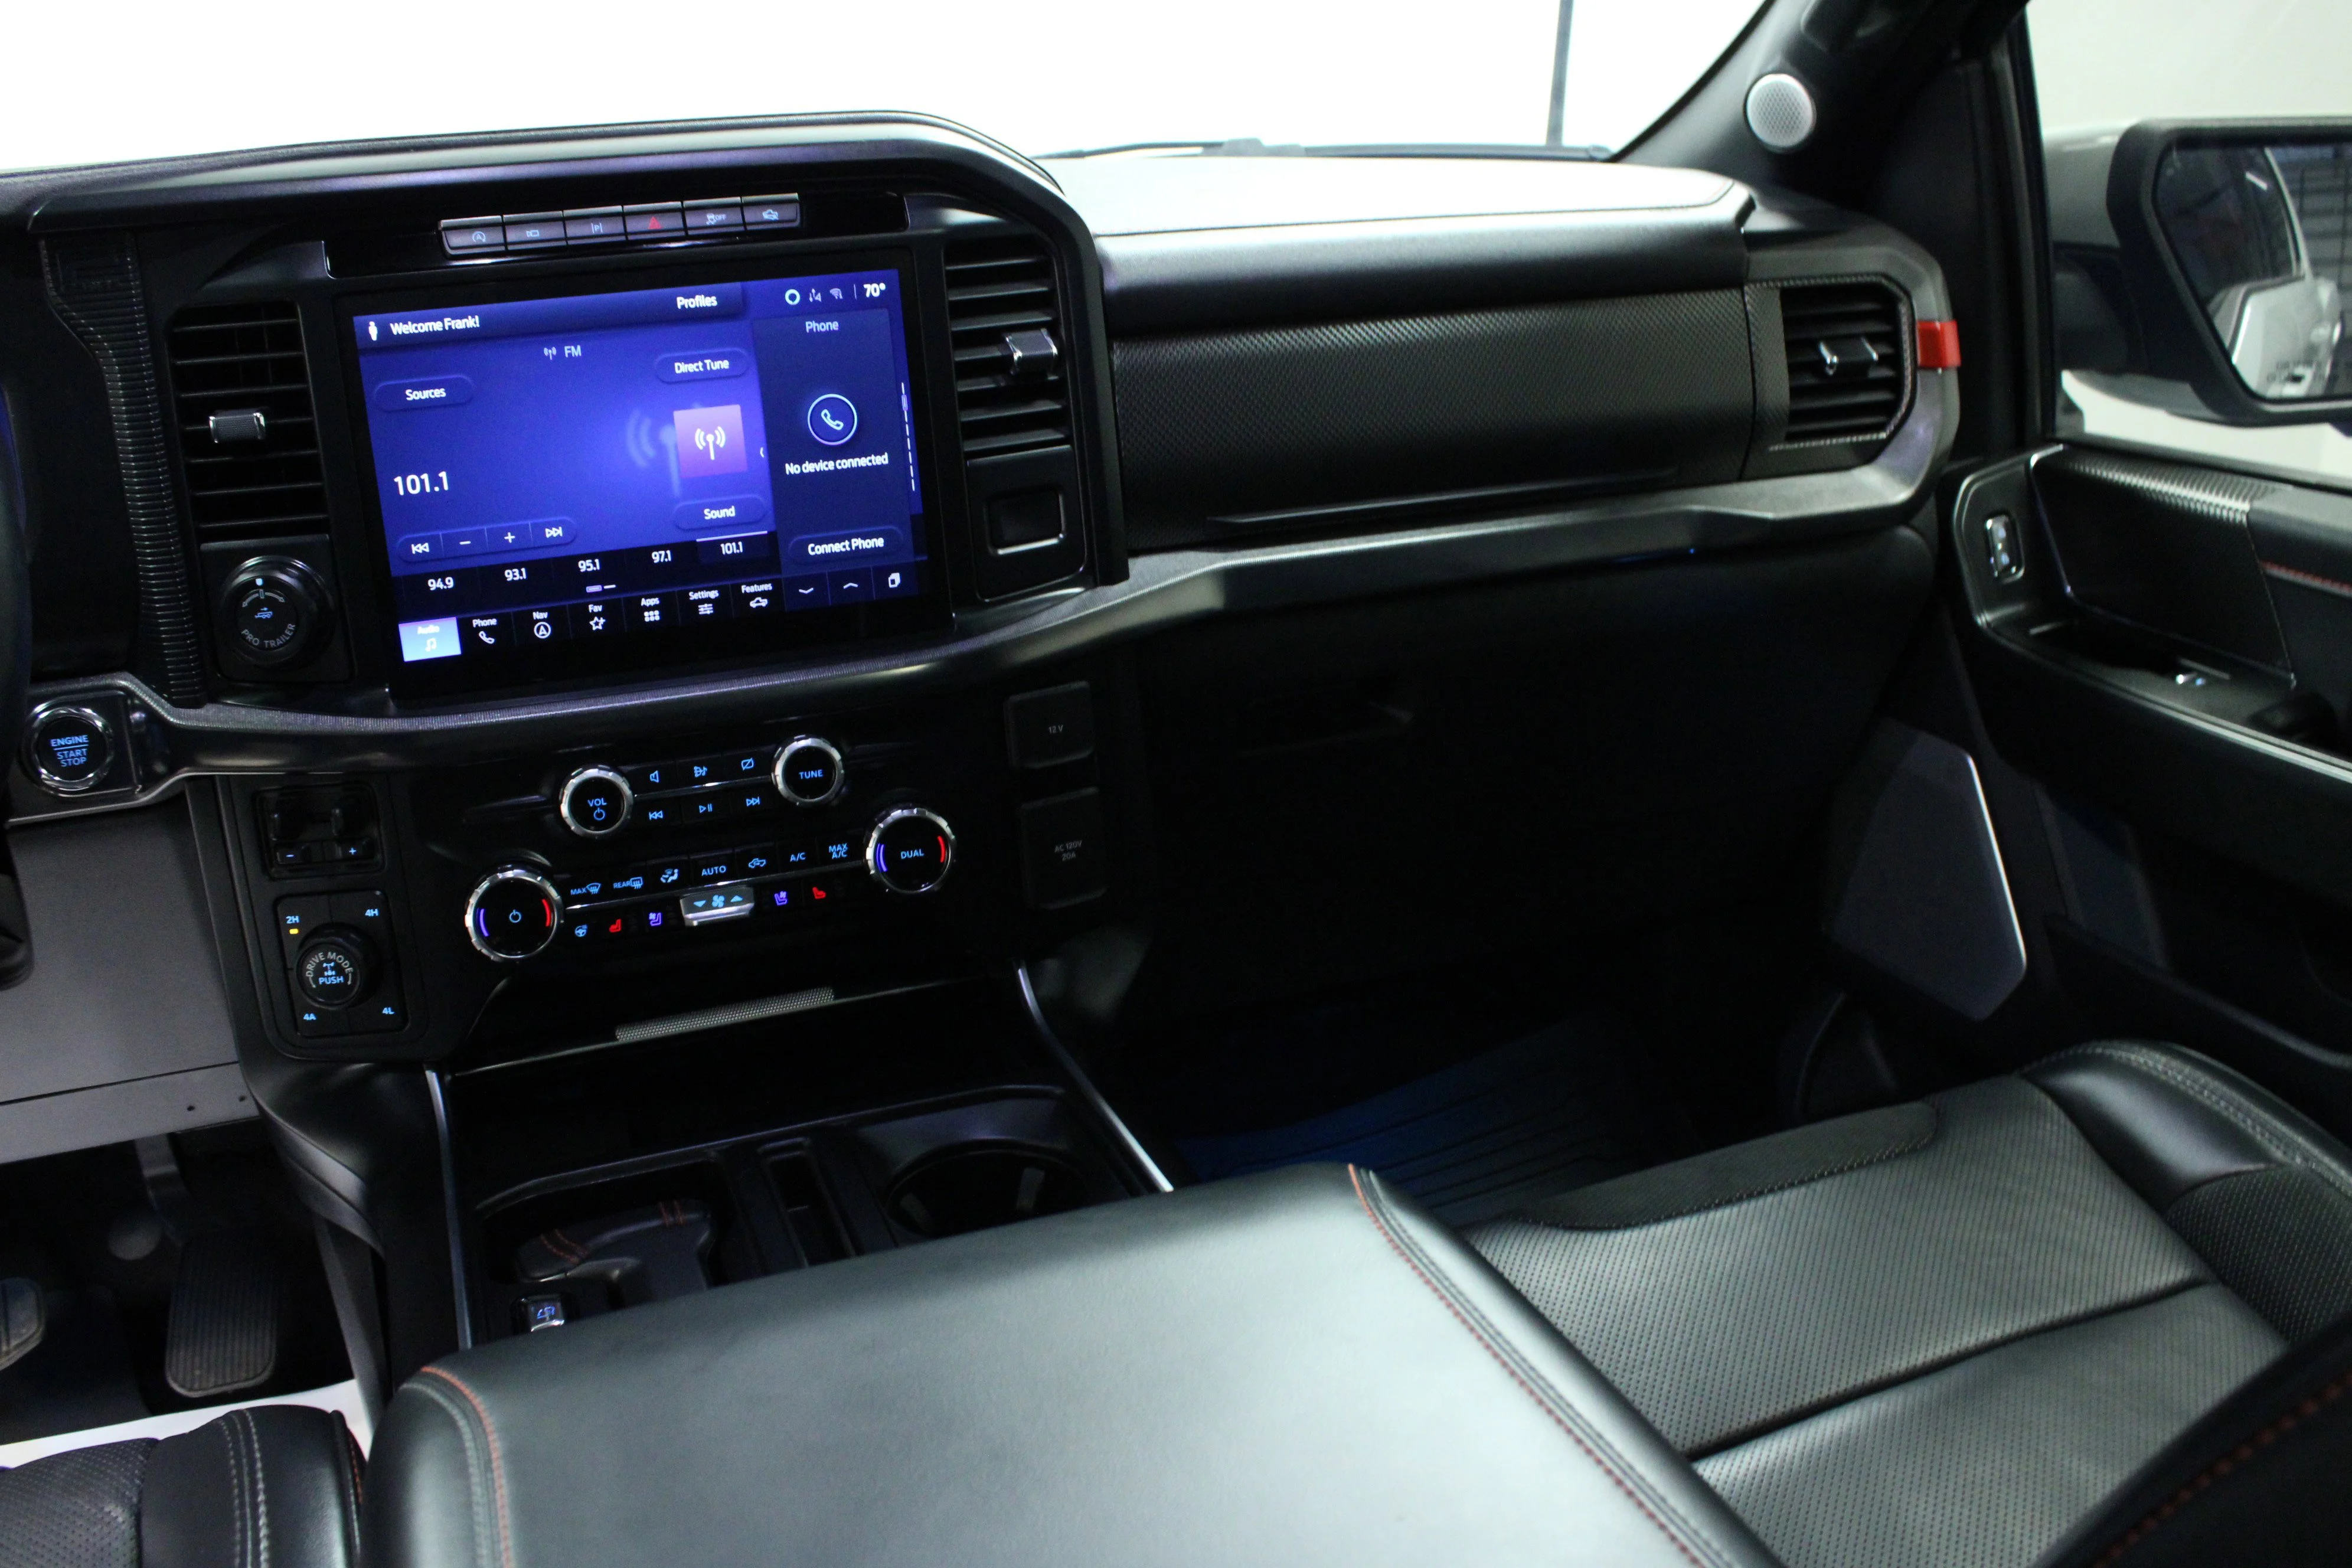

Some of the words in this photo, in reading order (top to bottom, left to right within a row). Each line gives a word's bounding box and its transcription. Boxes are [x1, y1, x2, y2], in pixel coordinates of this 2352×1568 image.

[677, 295, 717, 309] Profiles
[390, 321, 443, 335] Welcome
[444, 315, 479, 330] Frank!
[806, 321, 838, 332] Phone
[564, 345, 582, 357] FM
[675, 361, 704, 374] Direct
[704, 360, 729, 370] Tune
[406, 388, 446, 400] Sources
[785, 463, 801, 475] No
[802, 460, 834, 473] device
[836, 452, 888, 469] connected
[394, 471, 448, 495] 101.1
[704, 506, 736, 520] Sound
[720, 541, 743, 554] 101.1
[808, 540, 850, 555] Connect
[851, 538, 884, 550] Phone
[652, 550, 671, 563] 97.1
[579, 559, 600, 571] 95.1
[505, 568, 526, 581] 93.1
[428, 577, 453, 590] 94.9
[741, 583, 772, 593] Features
[689, 590, 719, 600] Settings
[641, 598, 659, 607] Apps
[533, 612, 548, 620] Nav
[473, 619, 496, 627] Phone
[241, 629, 260, 645] PRO
[264, 623, 296, 648] TRAILER
[51, 735, 89, 746] ENGINE
[57, 749, 87, 759] START
[61, 757, 87, 767] STOP
[799, 770, 822, 779] TUNE
[588, 798, 607, 807] VOL
[829, 843, 848, 853] MAX
[790, 852, 805, 861] A/C
[832, 850, 848, 859] A/C
[901, 849, 924, 859] DUAL
[702, 865, 726, 876] AUTO
[306, 952, 325, 978] DRIVE
[327, 952, 353, 973] MODE
[319, 976, 344, 984] PUSH
